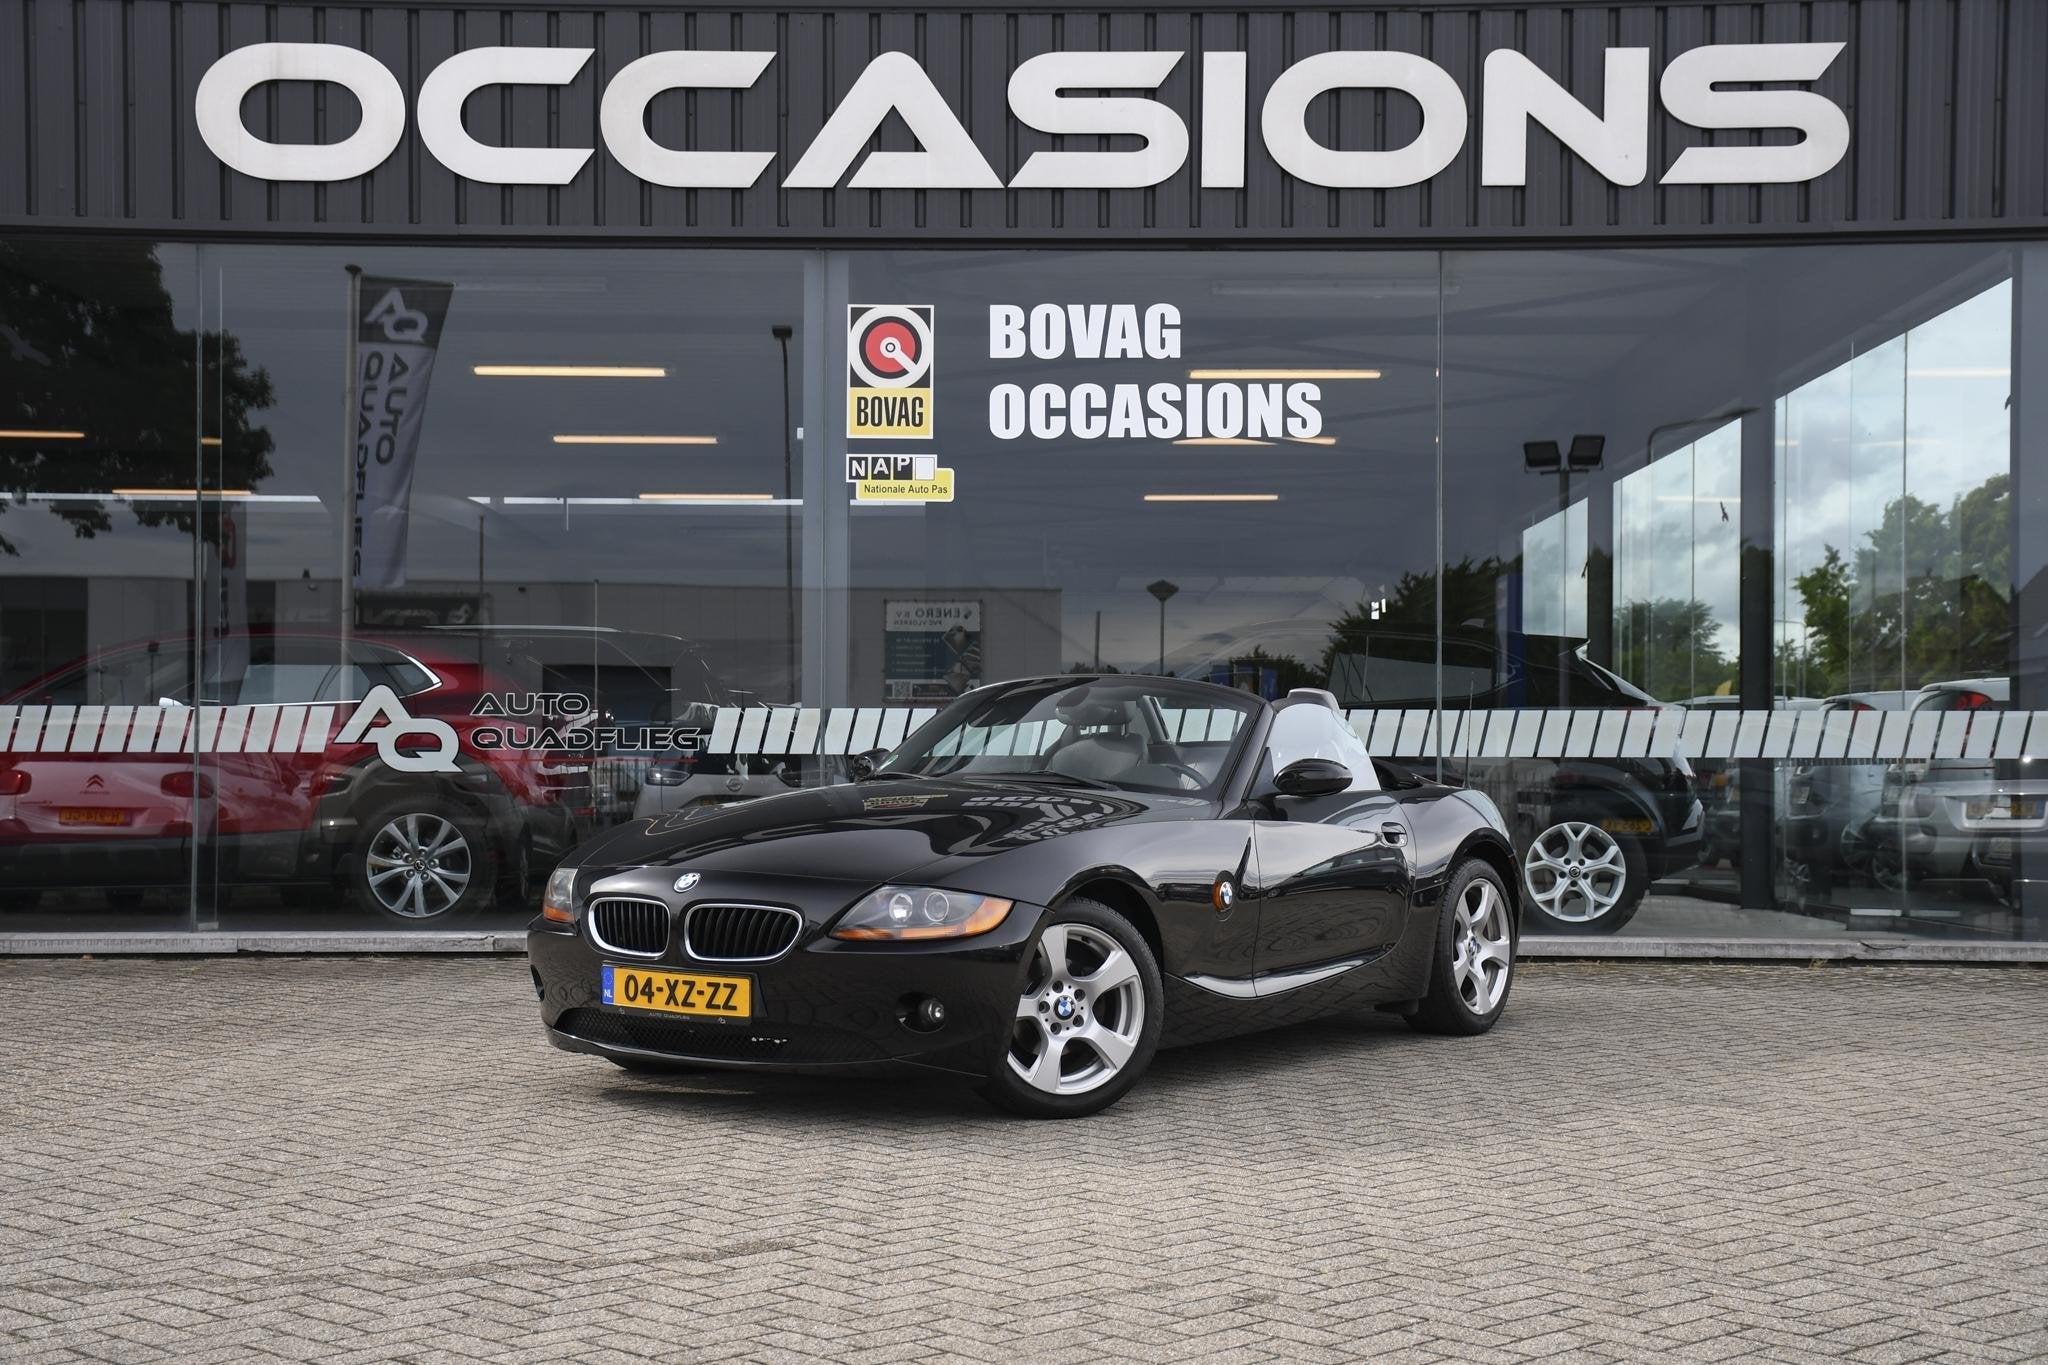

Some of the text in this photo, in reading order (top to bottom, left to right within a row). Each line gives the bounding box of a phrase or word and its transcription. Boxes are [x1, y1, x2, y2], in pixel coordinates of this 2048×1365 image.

[195, 42, 1850, 189] OCCASIONS
[989, 303, 1182, 360] BOVAG
[375, 352, 409, 466] AUTO
[856, 396, 924, 428] BOVAG
[989, 383, 1323, 440] OCCASIONS
[851, 456, 911, 477] NAP
[864, 484, 948, 494] Nationale Auto Pas
[471, 692, 591, 716] AUTO
[471, 727, 702, 751] QUADFLIEG
[603, 988, 613, 998] NL
[624, 974, 738, 1011] 04-XZ-ZZ
